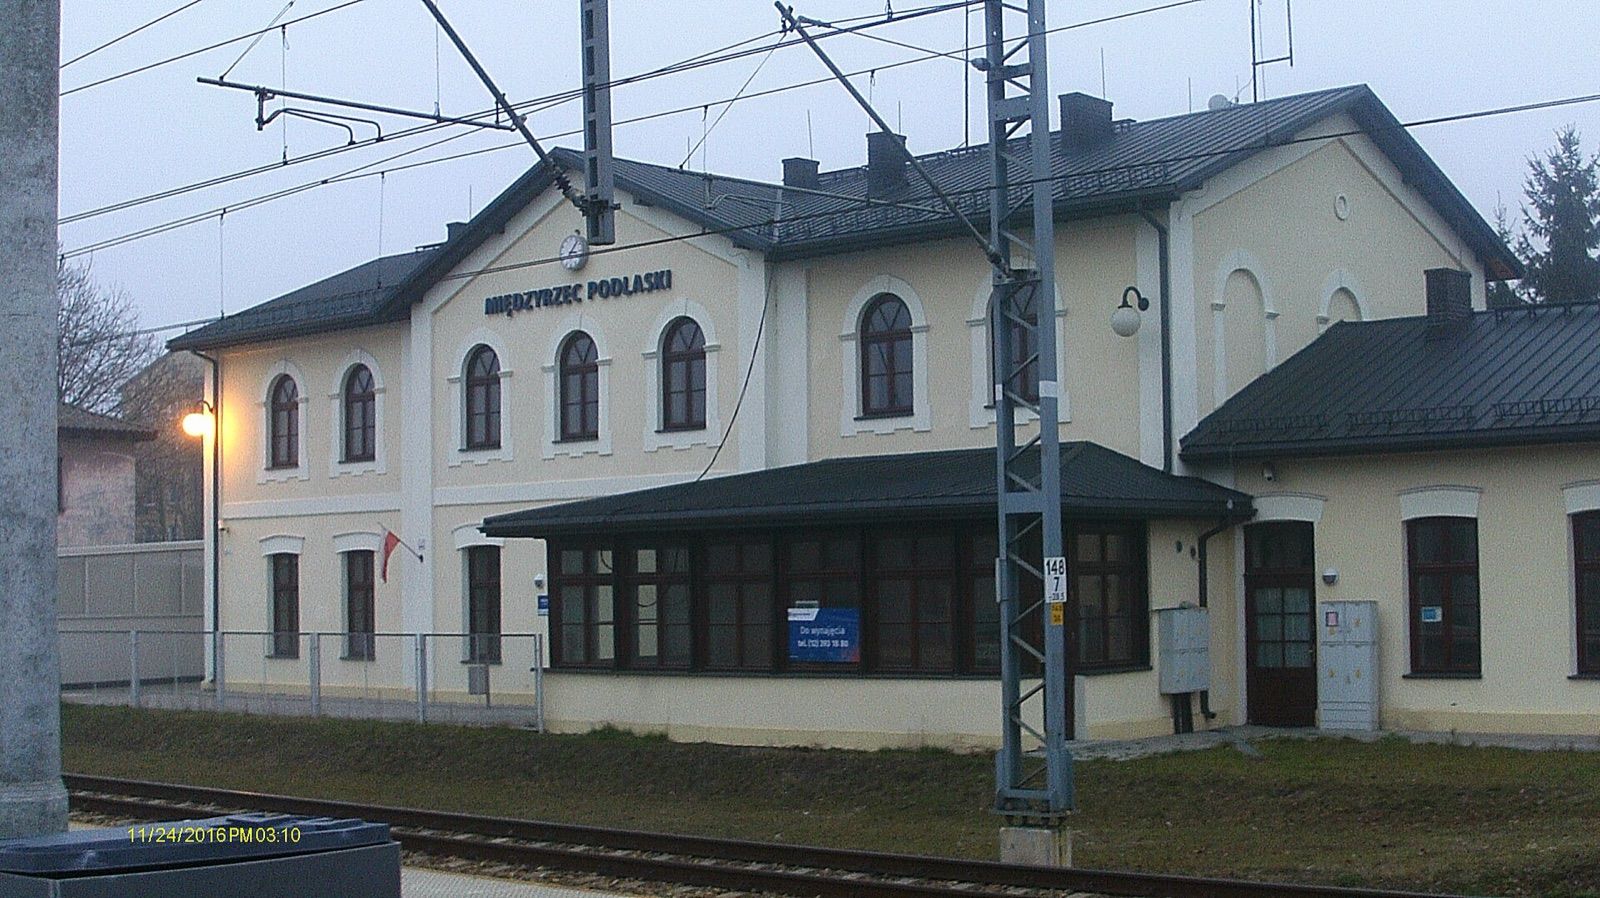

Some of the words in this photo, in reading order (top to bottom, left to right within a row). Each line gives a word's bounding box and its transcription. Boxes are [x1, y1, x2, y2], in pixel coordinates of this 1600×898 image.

[484, 283, 583, 316] MIĘDZYRZEC
[587, 269, 672, 300] PODLASKI
[1046, 559, 1065, 575] 148
[1053, 576, 1060, 592] 7
[800, 626, 810, 635] Do
[811, 625, 846, 637] wynajęcia
